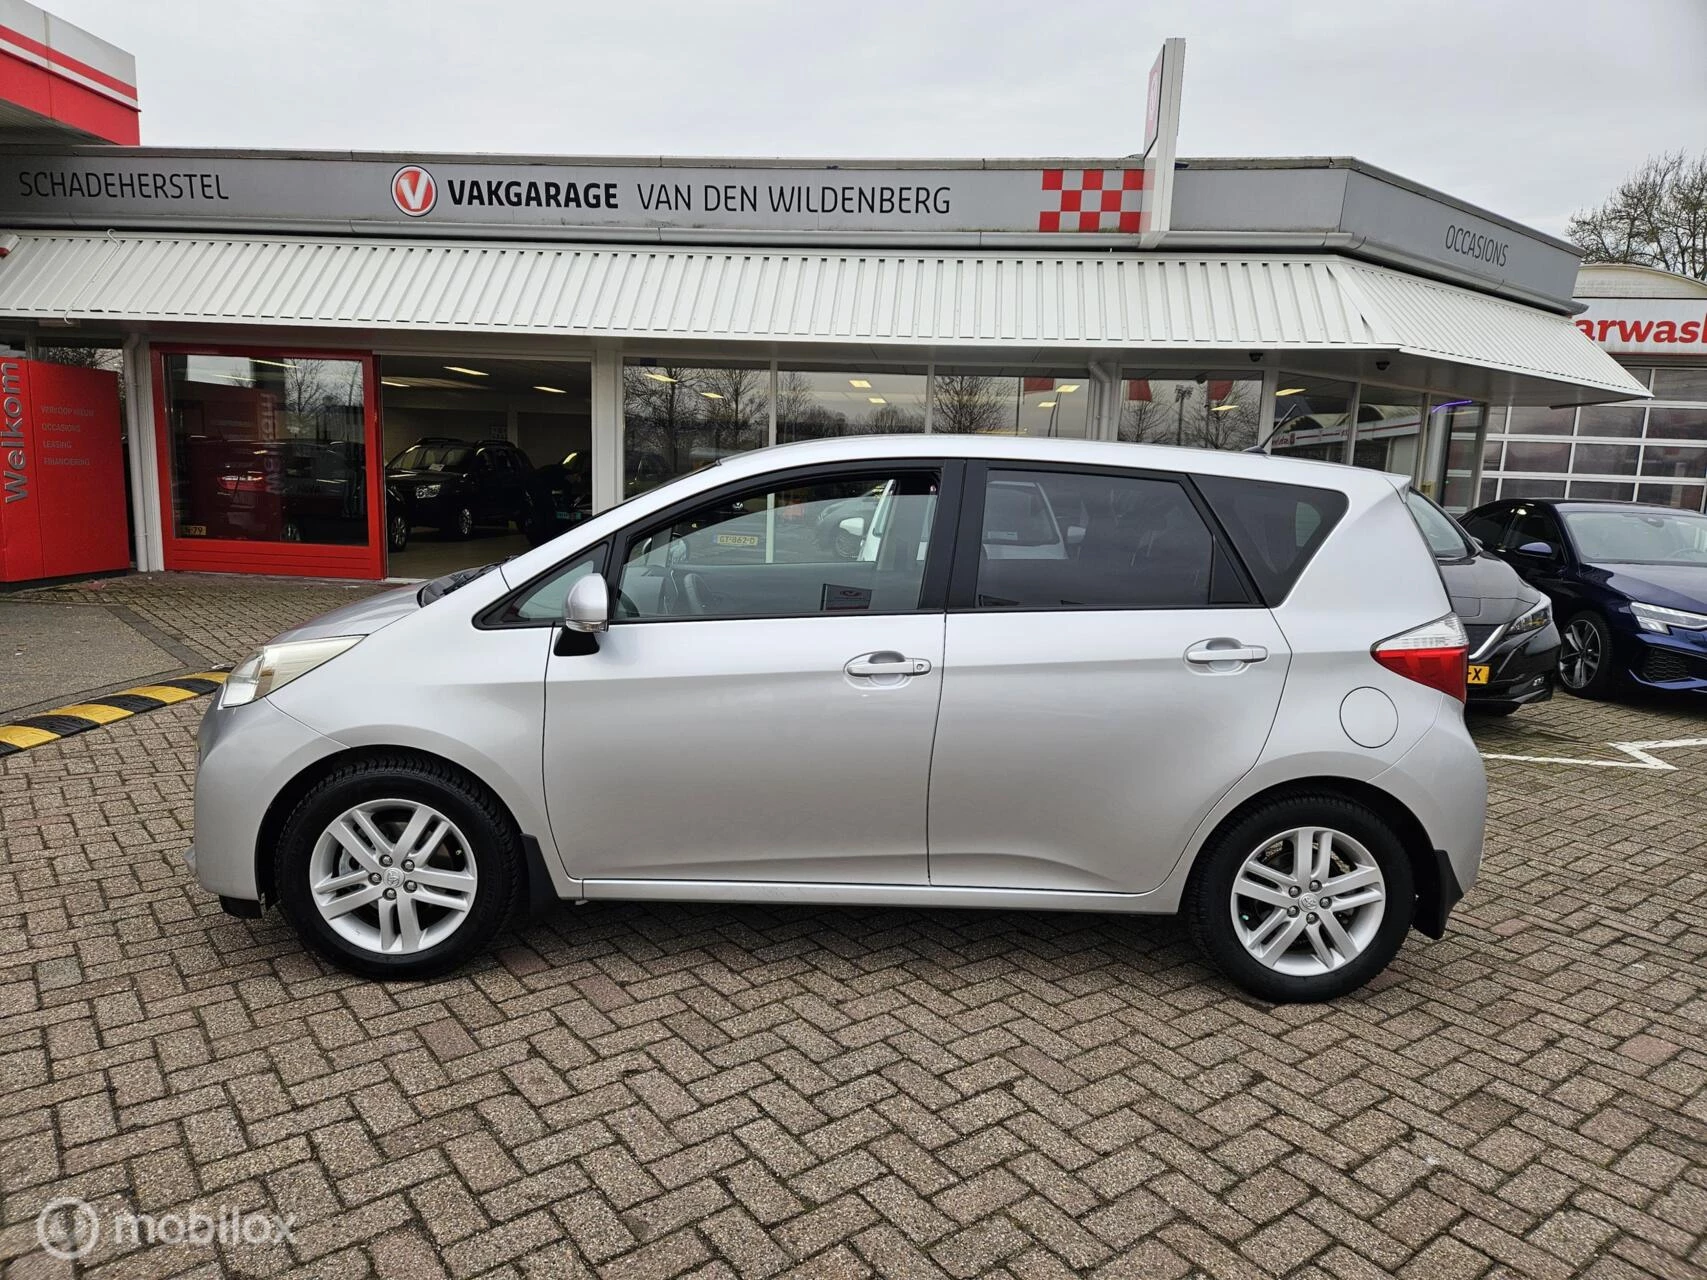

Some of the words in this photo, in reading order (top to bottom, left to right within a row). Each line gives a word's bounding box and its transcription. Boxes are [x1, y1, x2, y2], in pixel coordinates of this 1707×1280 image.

[18, 171, 229, 200] SCHADEHERSTEL
[448, 179, 619, 209] VAKGARAGE
[637, 183, 691, 211] VAN
[703, 184, 757, 212] DEN
[768, 185, 951, 214] WILDENBERG
[1445, 224, 1509, 267] OCCASIONS
[1575, 312, 1707, 343] arwas
[1, 362, 28, 503] Welkom
[41, 423, 81, 432] OCCASIONS
[43, 440, 73, 449] LEASING
